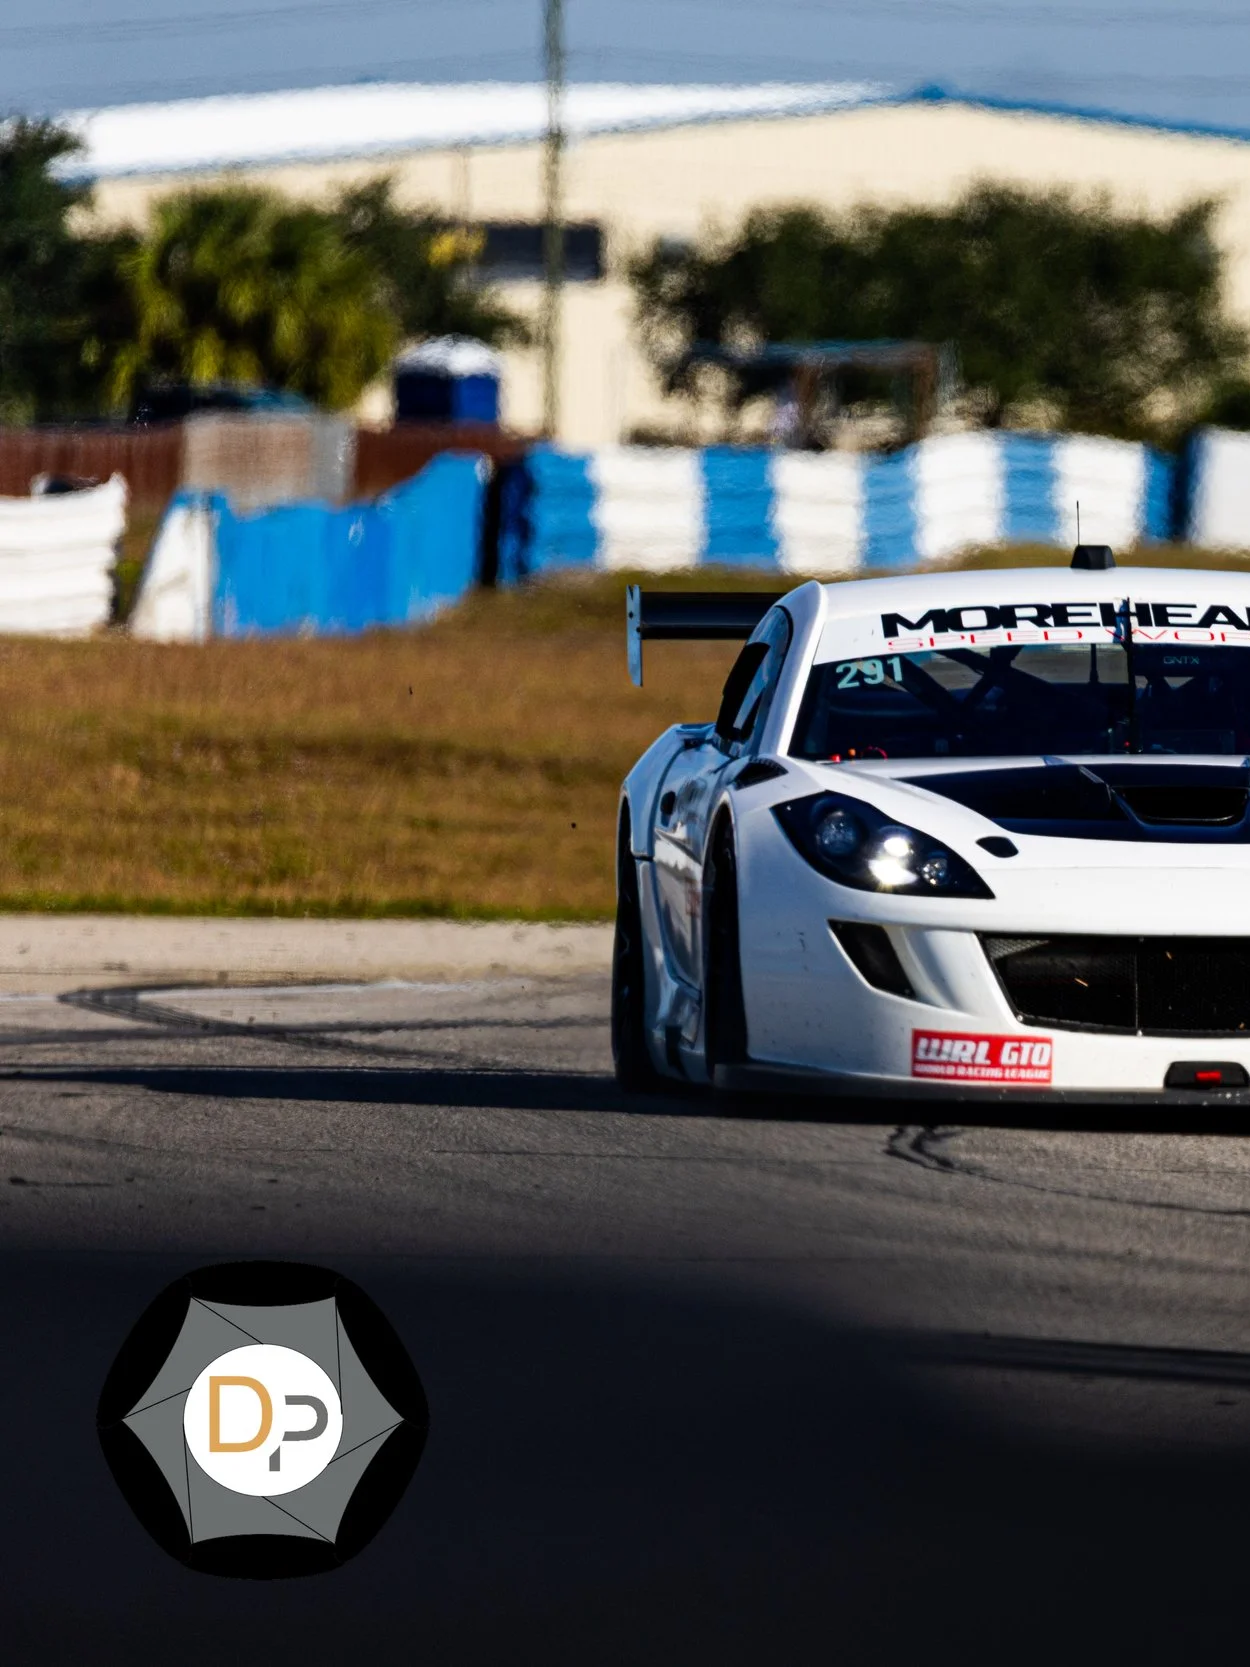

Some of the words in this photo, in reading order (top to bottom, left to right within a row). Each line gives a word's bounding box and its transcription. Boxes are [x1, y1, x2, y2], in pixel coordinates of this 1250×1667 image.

[887, 630, 1083, 651] SPEED
[835, 656, 903, 690] 291
[916, 1037, 991, 1065] WRL
[957, 1065, 1002, 1079] RACING
[1004, 1067, 1051, 1080] LEAGUE
